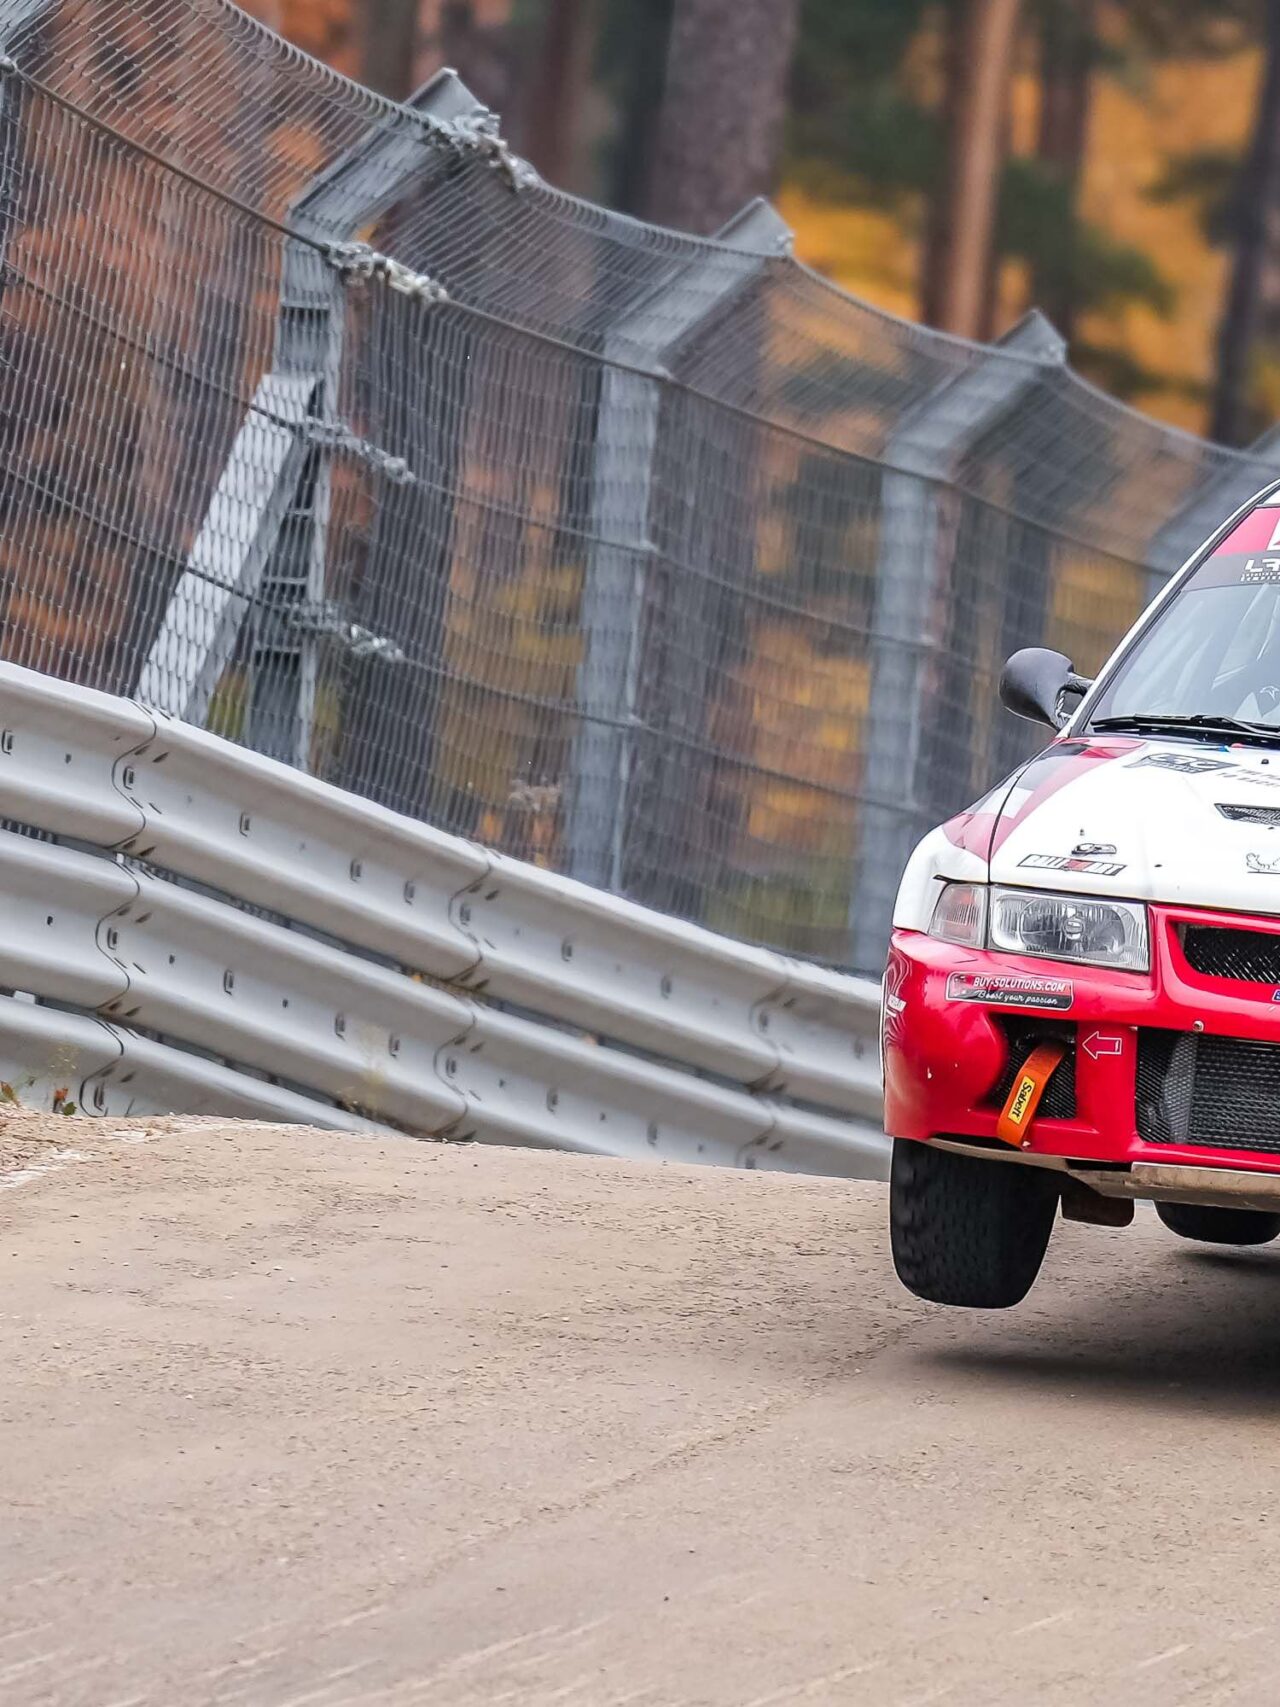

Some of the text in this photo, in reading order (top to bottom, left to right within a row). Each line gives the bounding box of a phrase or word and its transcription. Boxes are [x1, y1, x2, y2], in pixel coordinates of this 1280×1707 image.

[973, 976, 1066, 993] BUY-SOLUTIONS.COM
[1004, 993, 1026, 1003] your
[1011, 1081, 1033, 1119] Sabelt
